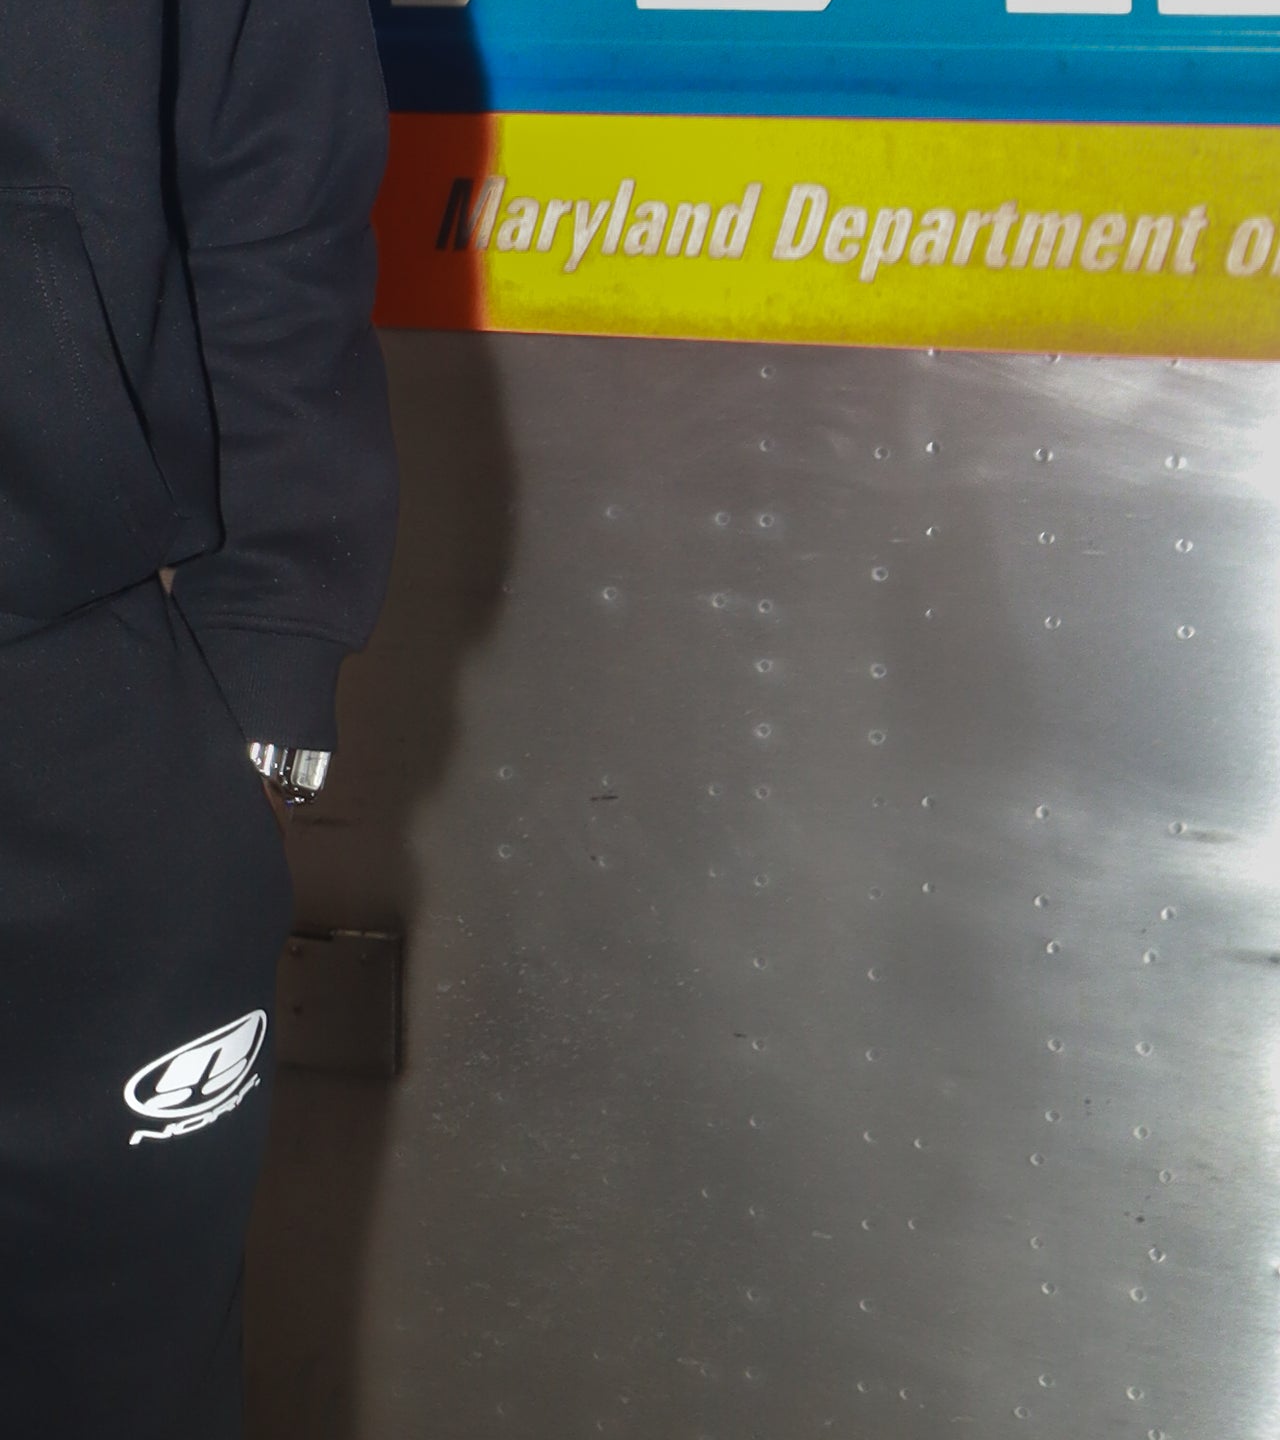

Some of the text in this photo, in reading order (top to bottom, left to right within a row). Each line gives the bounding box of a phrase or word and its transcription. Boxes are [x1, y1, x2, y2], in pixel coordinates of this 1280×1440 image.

[435, 176, 1280, 283] Maryland Department o
